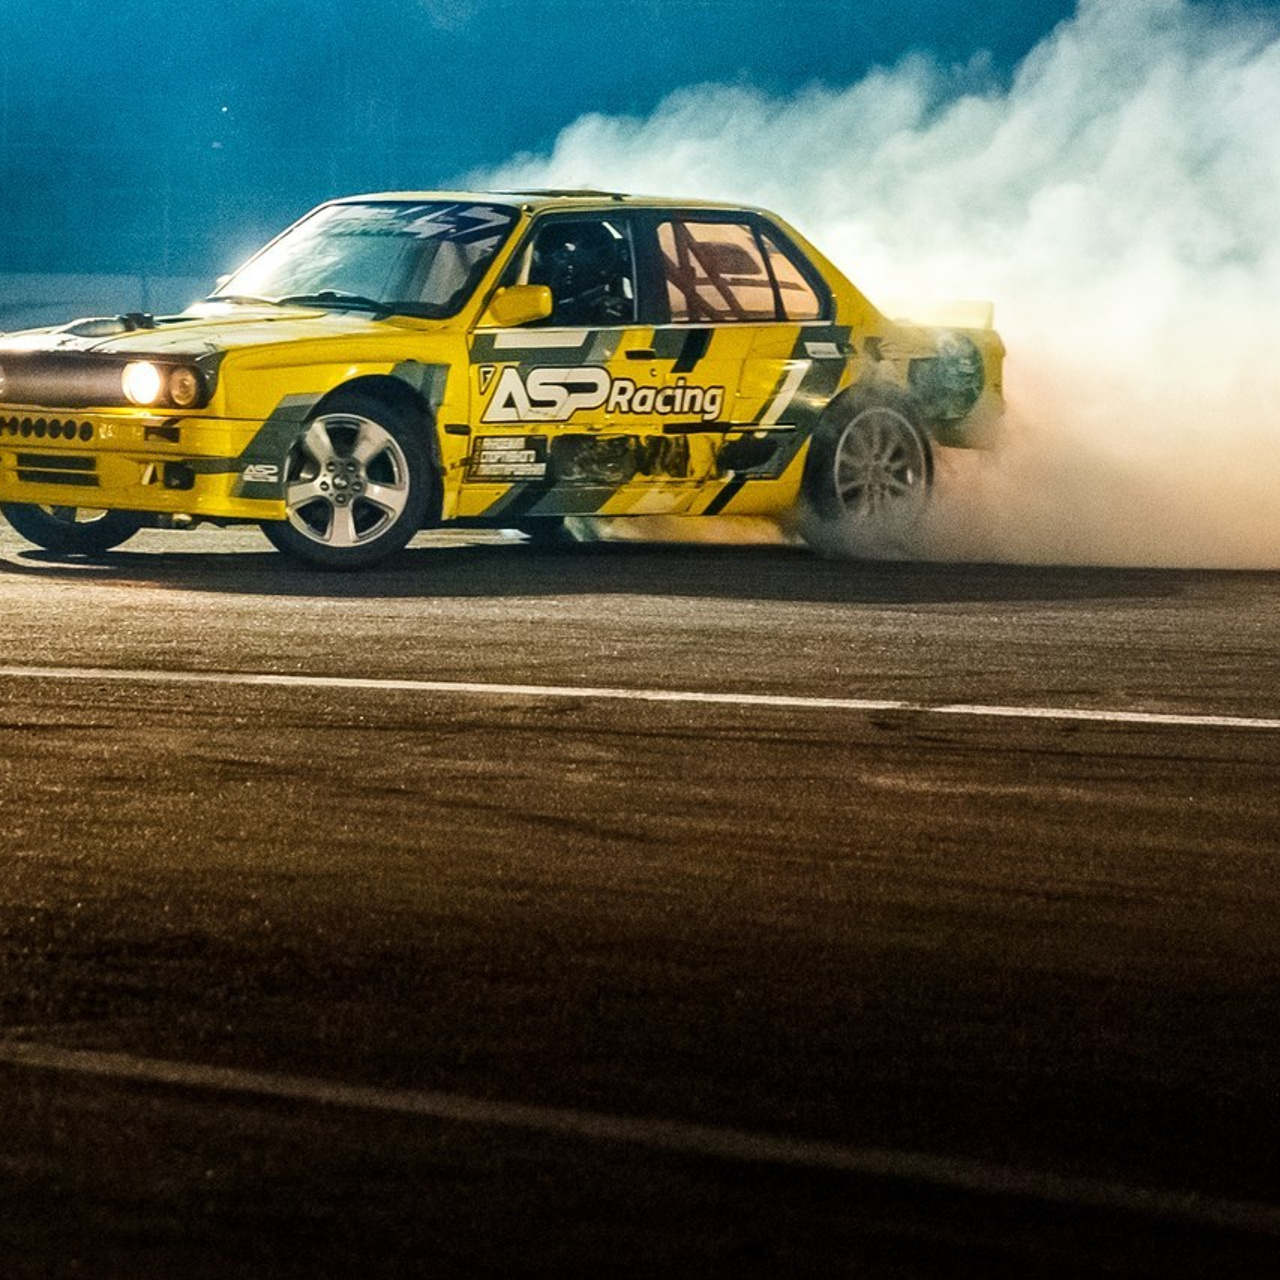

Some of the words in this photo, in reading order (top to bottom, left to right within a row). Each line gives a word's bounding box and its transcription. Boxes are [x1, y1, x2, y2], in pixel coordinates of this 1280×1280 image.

[482, 366, 611, 422] ASP
[607, 378, 724, 421] Racing
[243, 464, 278, 475] ASP
